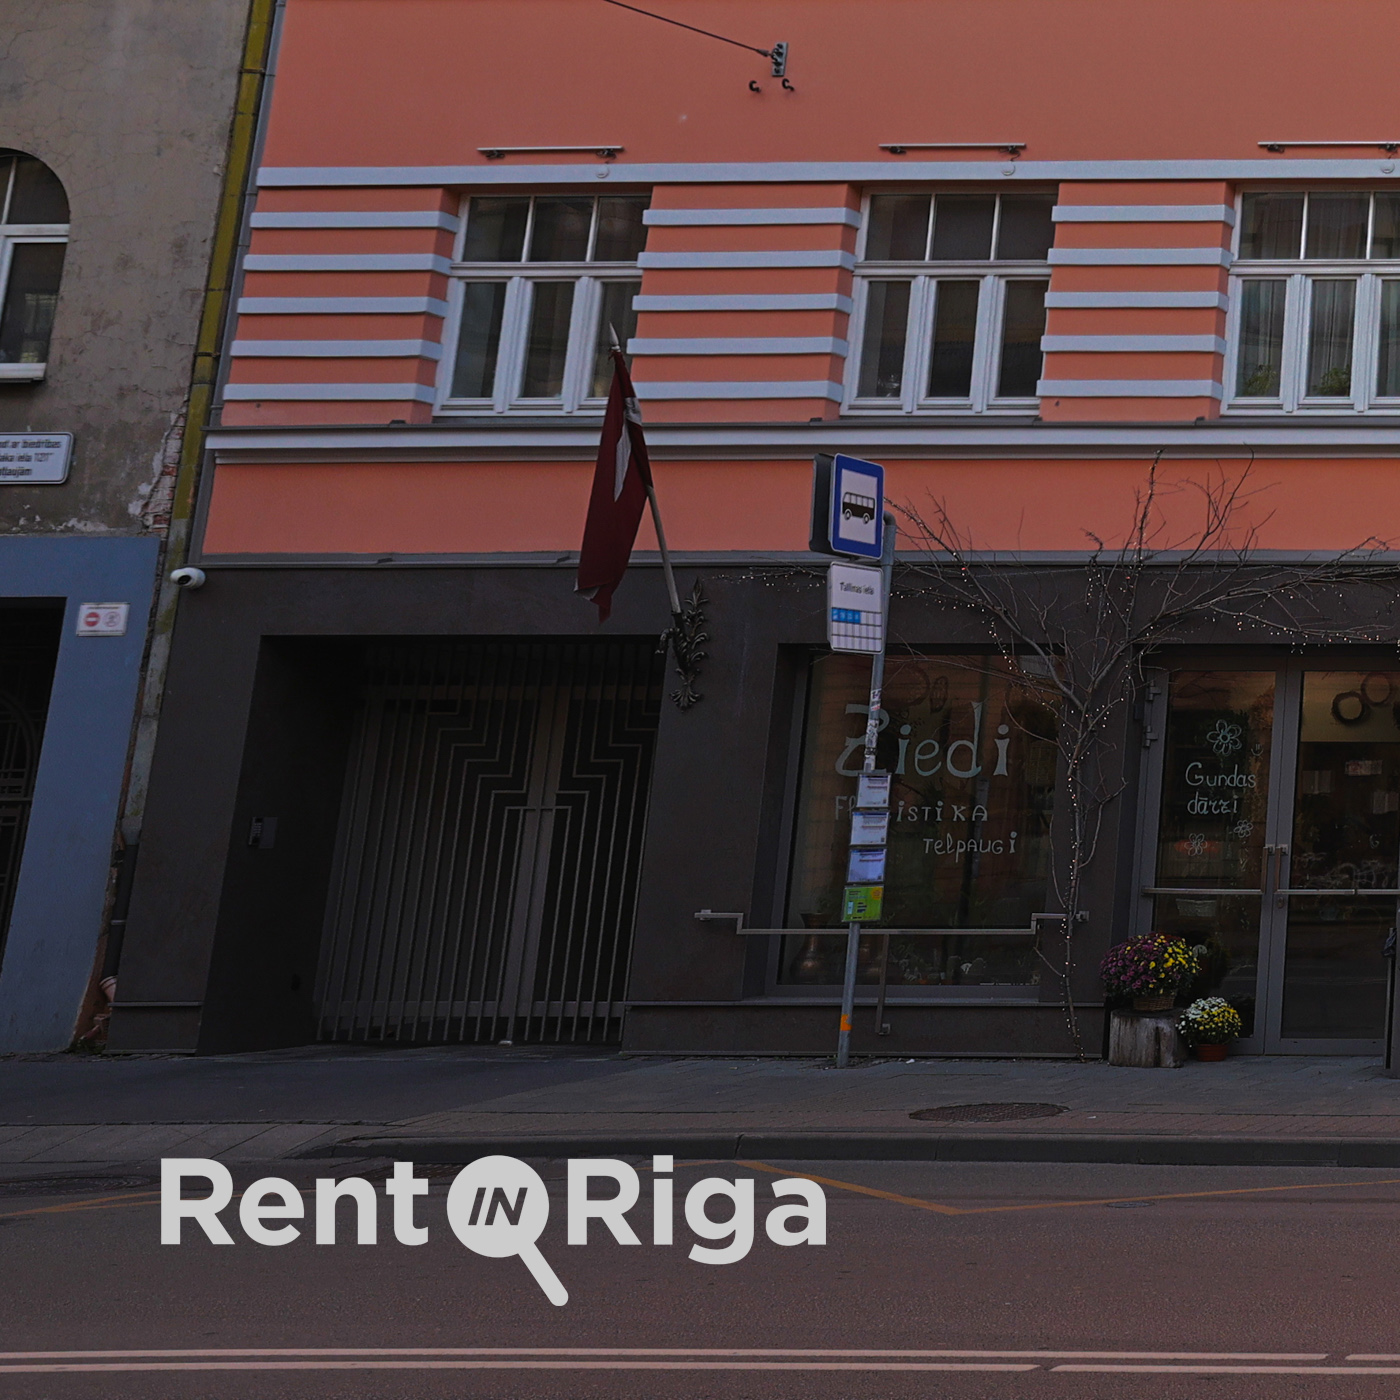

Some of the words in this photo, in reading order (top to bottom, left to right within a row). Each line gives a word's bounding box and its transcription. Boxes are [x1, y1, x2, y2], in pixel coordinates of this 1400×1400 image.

[840, 582, 862, 594] Tallinas
[863, 584, 875, 595] iela
[835, 701, 1009, 777] Ziedi
[1185, 762, 1256, 788] Gundas
[1186, 791, 1239, 815] dārzi
